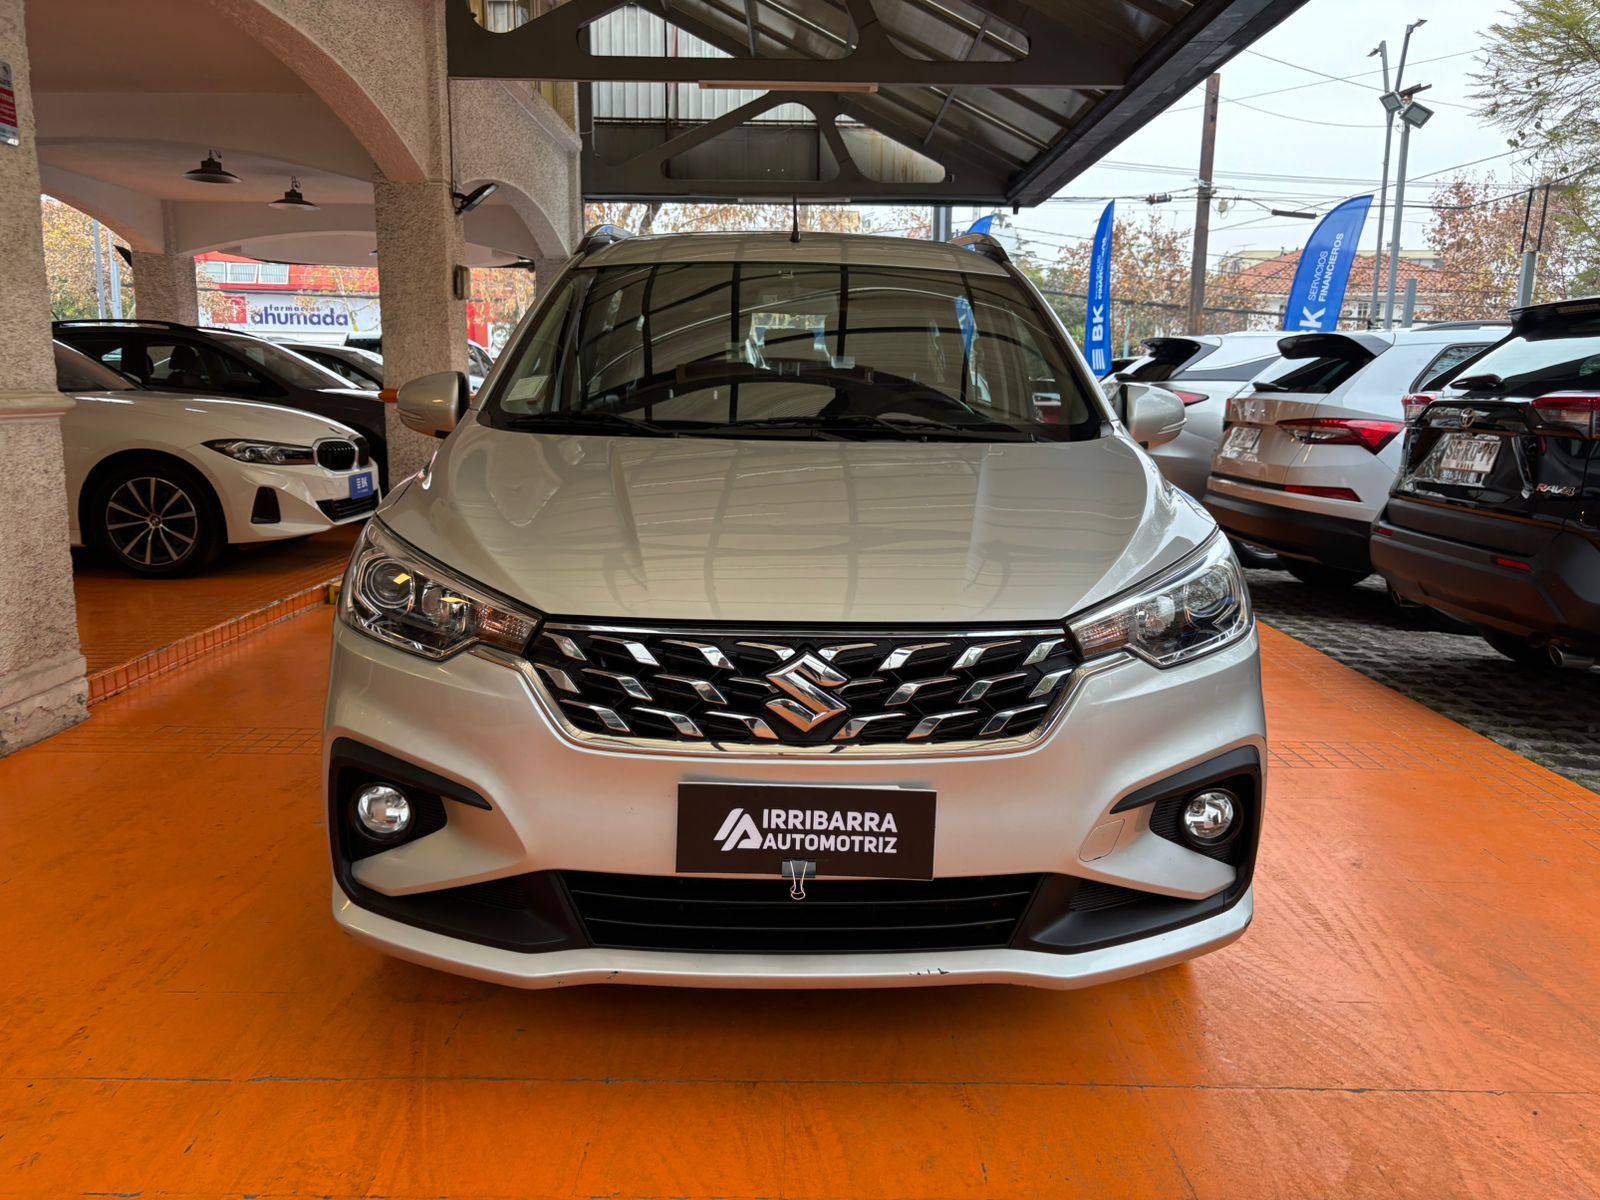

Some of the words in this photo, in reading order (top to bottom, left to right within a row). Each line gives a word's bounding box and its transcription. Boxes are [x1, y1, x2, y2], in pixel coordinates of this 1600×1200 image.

[1308, 250, 1329, 301] SERVICIOS
[1318, 232, 1344, 302] FINANCIEROS
[250, 306, 349, 326] ahumada
[1092, 304, 1104, 342] BK
[1299, 306, 1327, 332] K
[762, 808, 898, 833] IRRIBARRA
[762, 833, 898, 854] AUTOMOTRIZ
